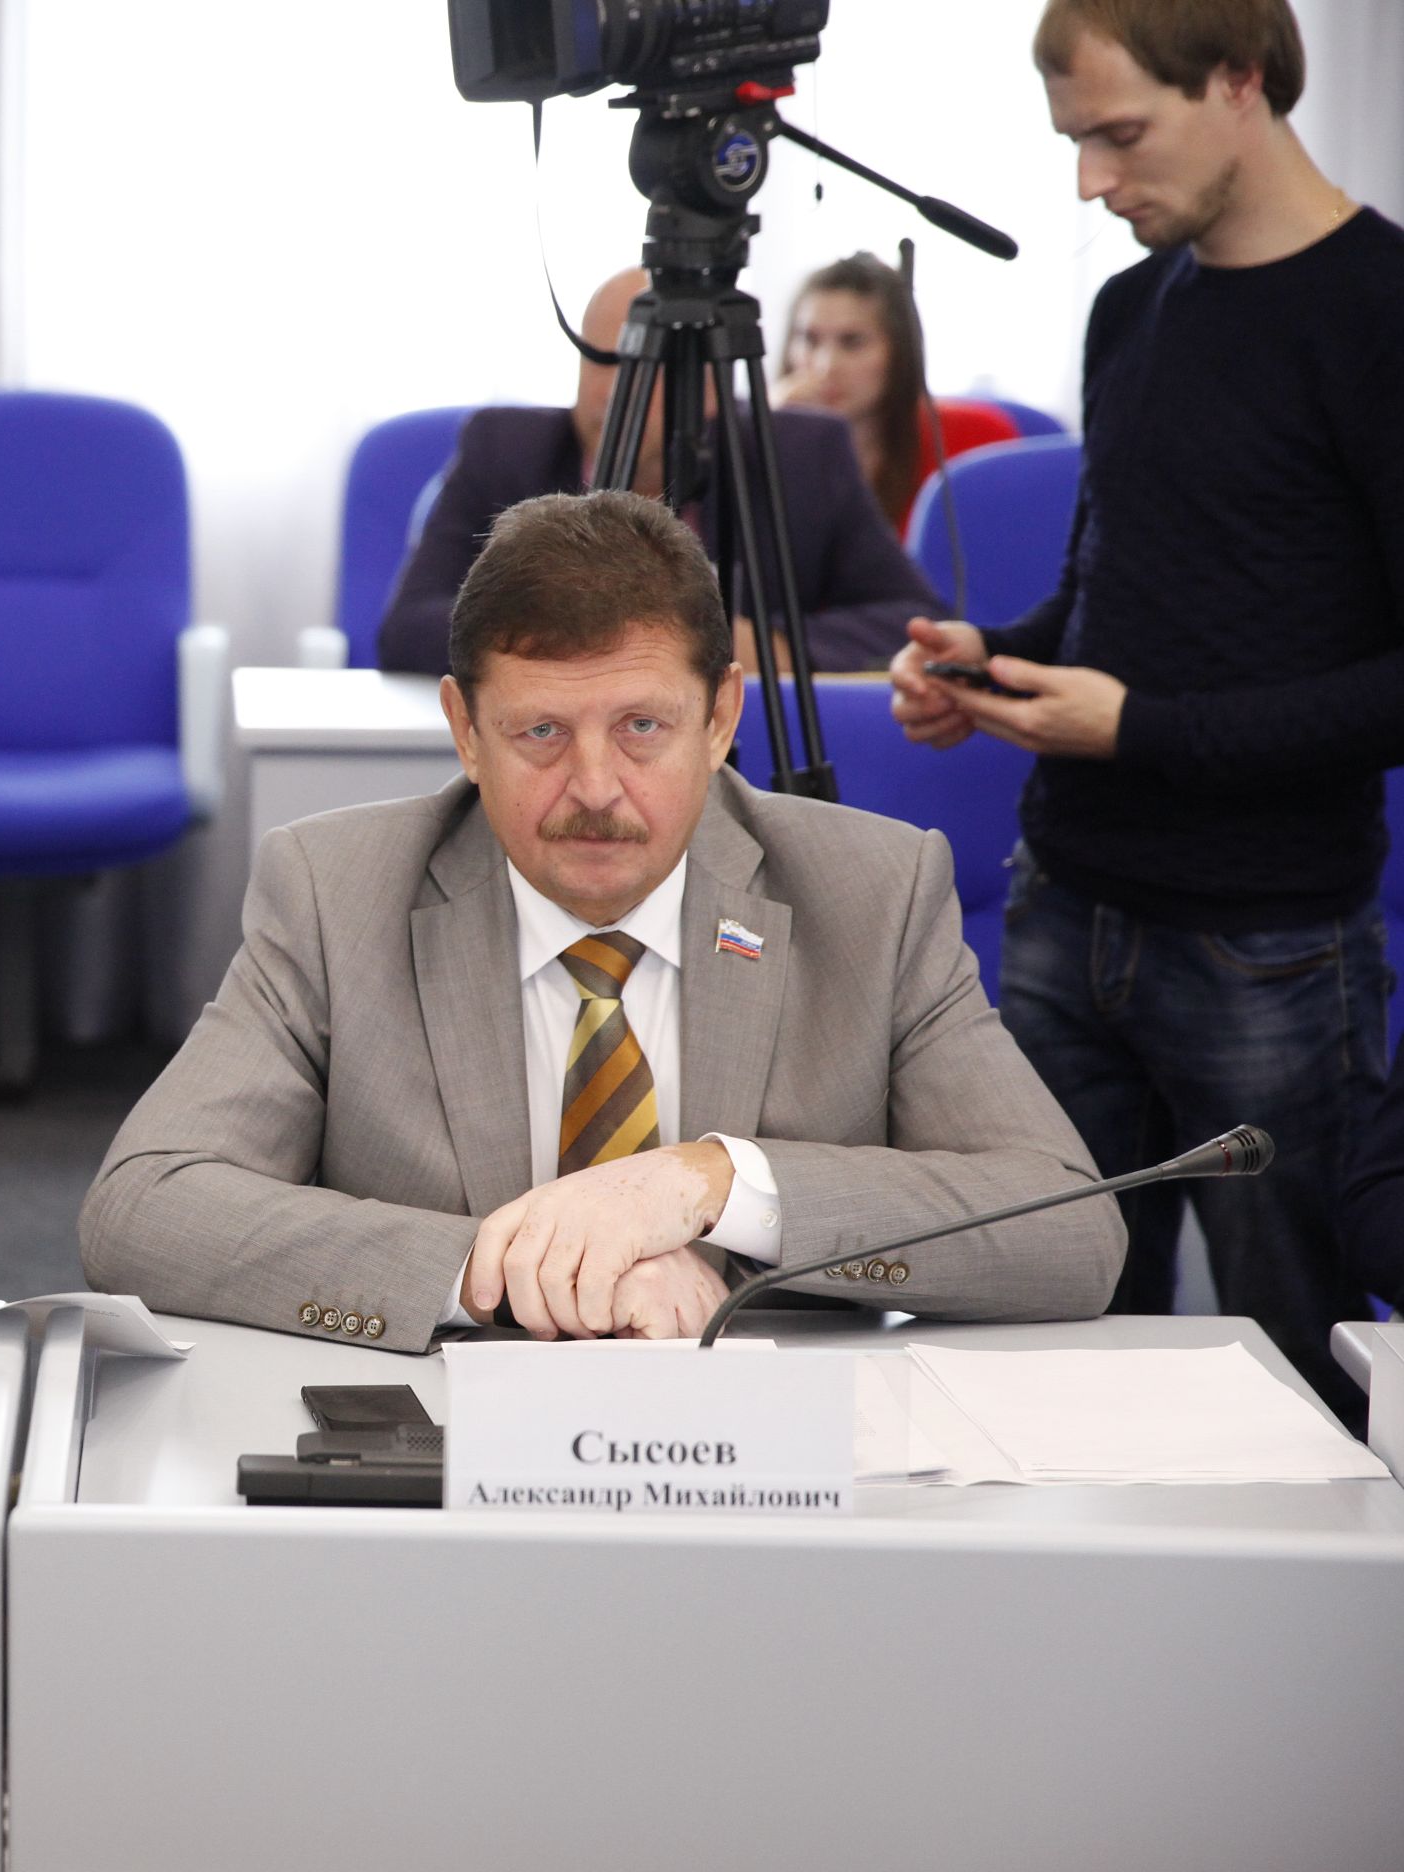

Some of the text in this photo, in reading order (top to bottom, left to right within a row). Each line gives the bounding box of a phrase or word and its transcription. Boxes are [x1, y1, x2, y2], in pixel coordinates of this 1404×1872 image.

[571, 1429, 738, 1466] Сысоев
[468, 1481, 841, 1512] Александр Михайлович
